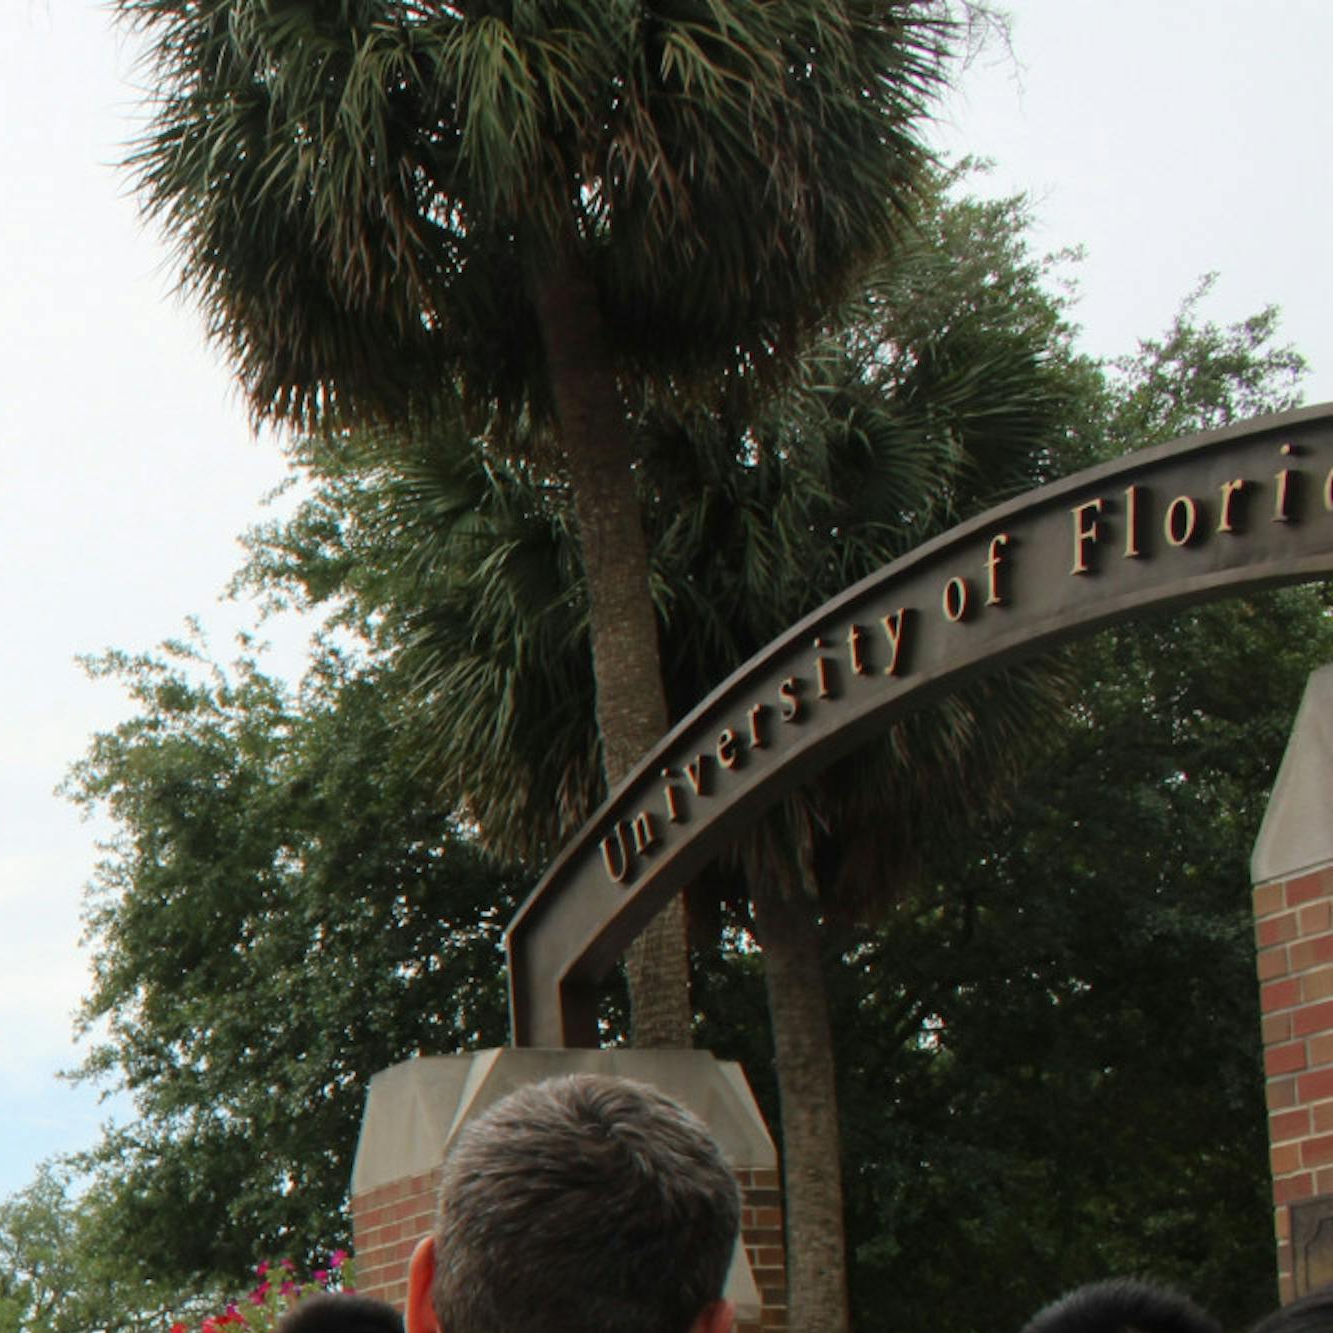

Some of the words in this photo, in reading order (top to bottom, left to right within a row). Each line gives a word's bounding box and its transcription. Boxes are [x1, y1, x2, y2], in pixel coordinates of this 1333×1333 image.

[598, 606, 908, 885] University
[942, 533, 1010, 624] of
[1069, 444, 1333, 577] Flori
